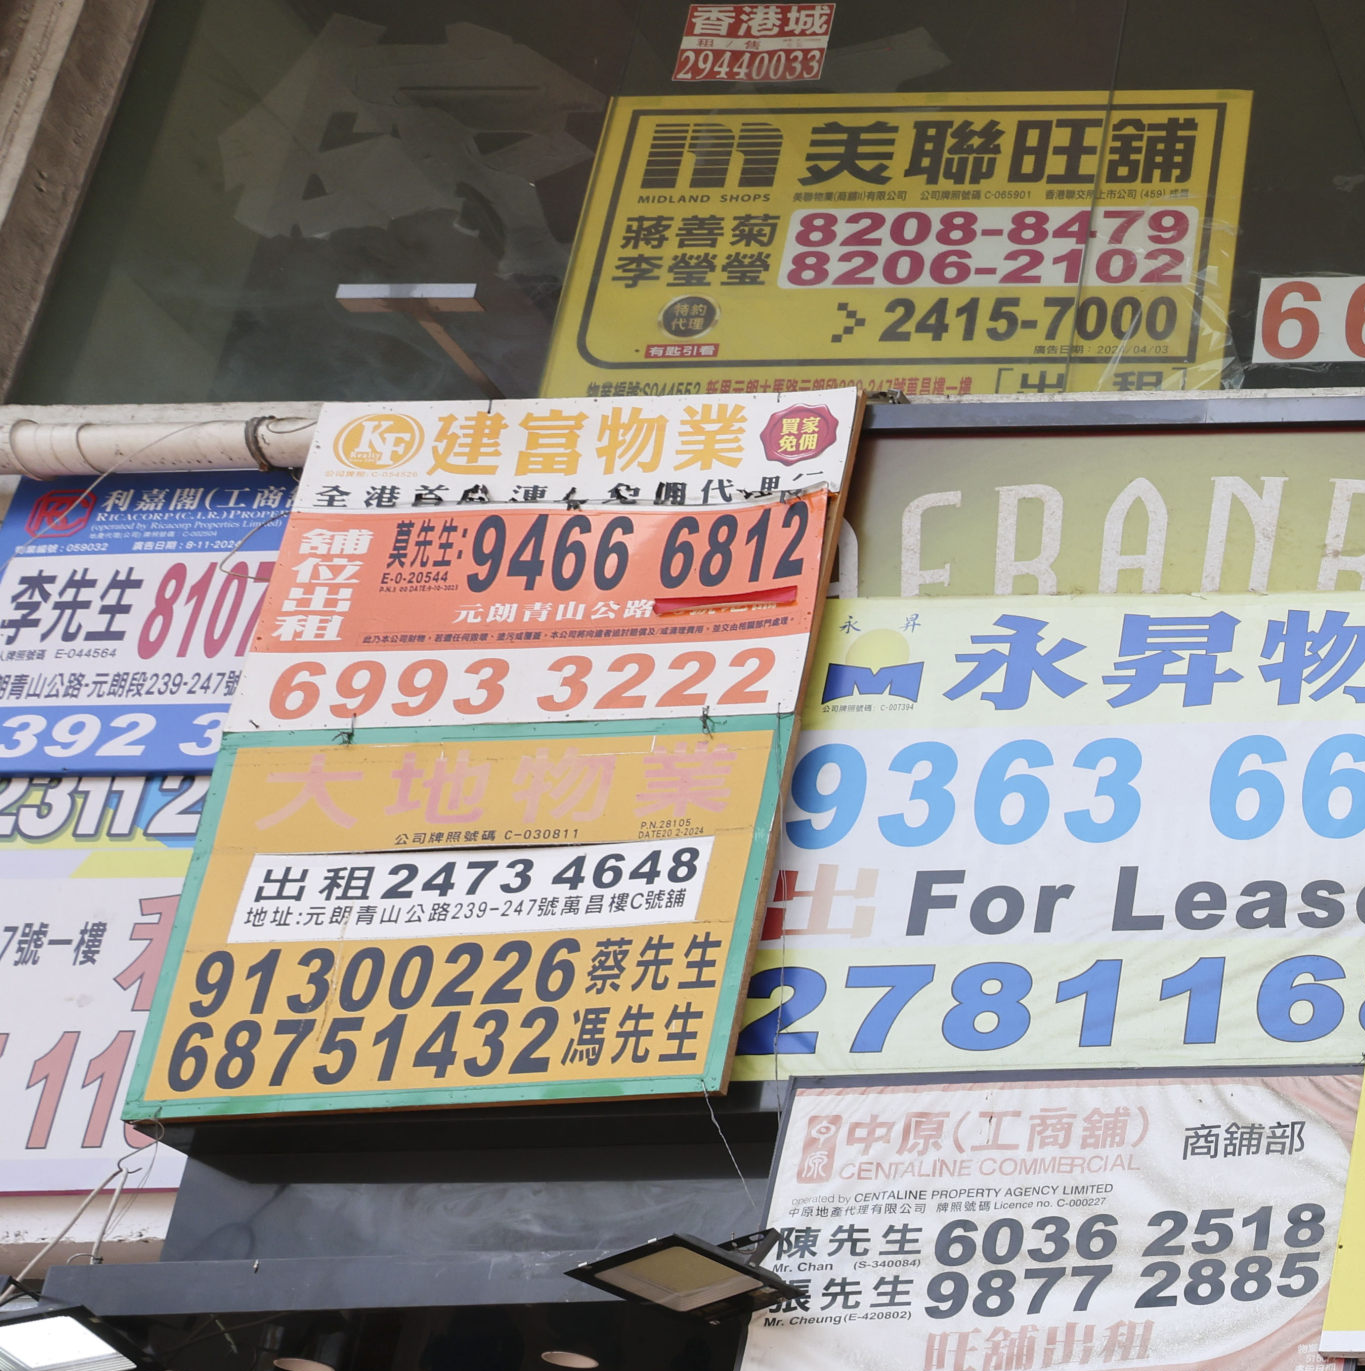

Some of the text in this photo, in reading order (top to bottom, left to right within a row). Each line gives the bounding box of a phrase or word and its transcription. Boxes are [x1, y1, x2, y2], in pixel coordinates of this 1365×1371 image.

[691, 5, 831, 36] 香港城
[676, 50, 821, 79] 29440033
[797, 117, 1198, 187] 美聯旺舖
[637, 193, 771, 204] MIDLAND SHOPS
[620, 210, 1190, 250] 蔣善菊 8208-8479
[611, 248, 1186, 289] 李瑩瑩 8206-2102
[879, 297, 1178, 343] 2415-7000
[426, 404, 748, 477] 建富物業
[778, 435, 816, 451] 免佣
[781, 417, 820, 435] 買家
[467, 514, 634, 593] 9466
[659, 504, 810, 589] 6812
[1, 567, 143, 645] 李先生
[452, 599, 653, 623] 元朗青山公路
[269, 647, 776, 720] 6993 3222
[255, 742, 731, 831] 大地物業
[783, 738, 1144, 847] 9363
[394, 828, 580, 845] 公司牌照號碼 C-030811
[380, 847, 699, 899] 2473 4648
[905, 871, 1072, 938] For
[191, 937, 581, 1017] 91300226
[167, 1006, 565, 1093] 68751432
[1182, 1119, 1306, 1161] 商舖部
[839, 1154, 1140, 1181] CENTALINE COMMERCIAL
[788, 1203, 927, 1218] 中原地產代理有限公司
[994, 1200, 1032, 1210] Licence
[1057, 1197, 1106, 1208] C-000227
[854, 1183, 1113, 1203] CENTALINE PROPERTY AGENCY LIMITED
[777, 1203, 1326, 1267] 陳先生 6036 2518
[773, 1259, 921, 1273] Mr. Chan (S-340084)
[924, 1254, 1321, 1319] 9877 2885
[764, 1317, 786, 1328] Mr.
